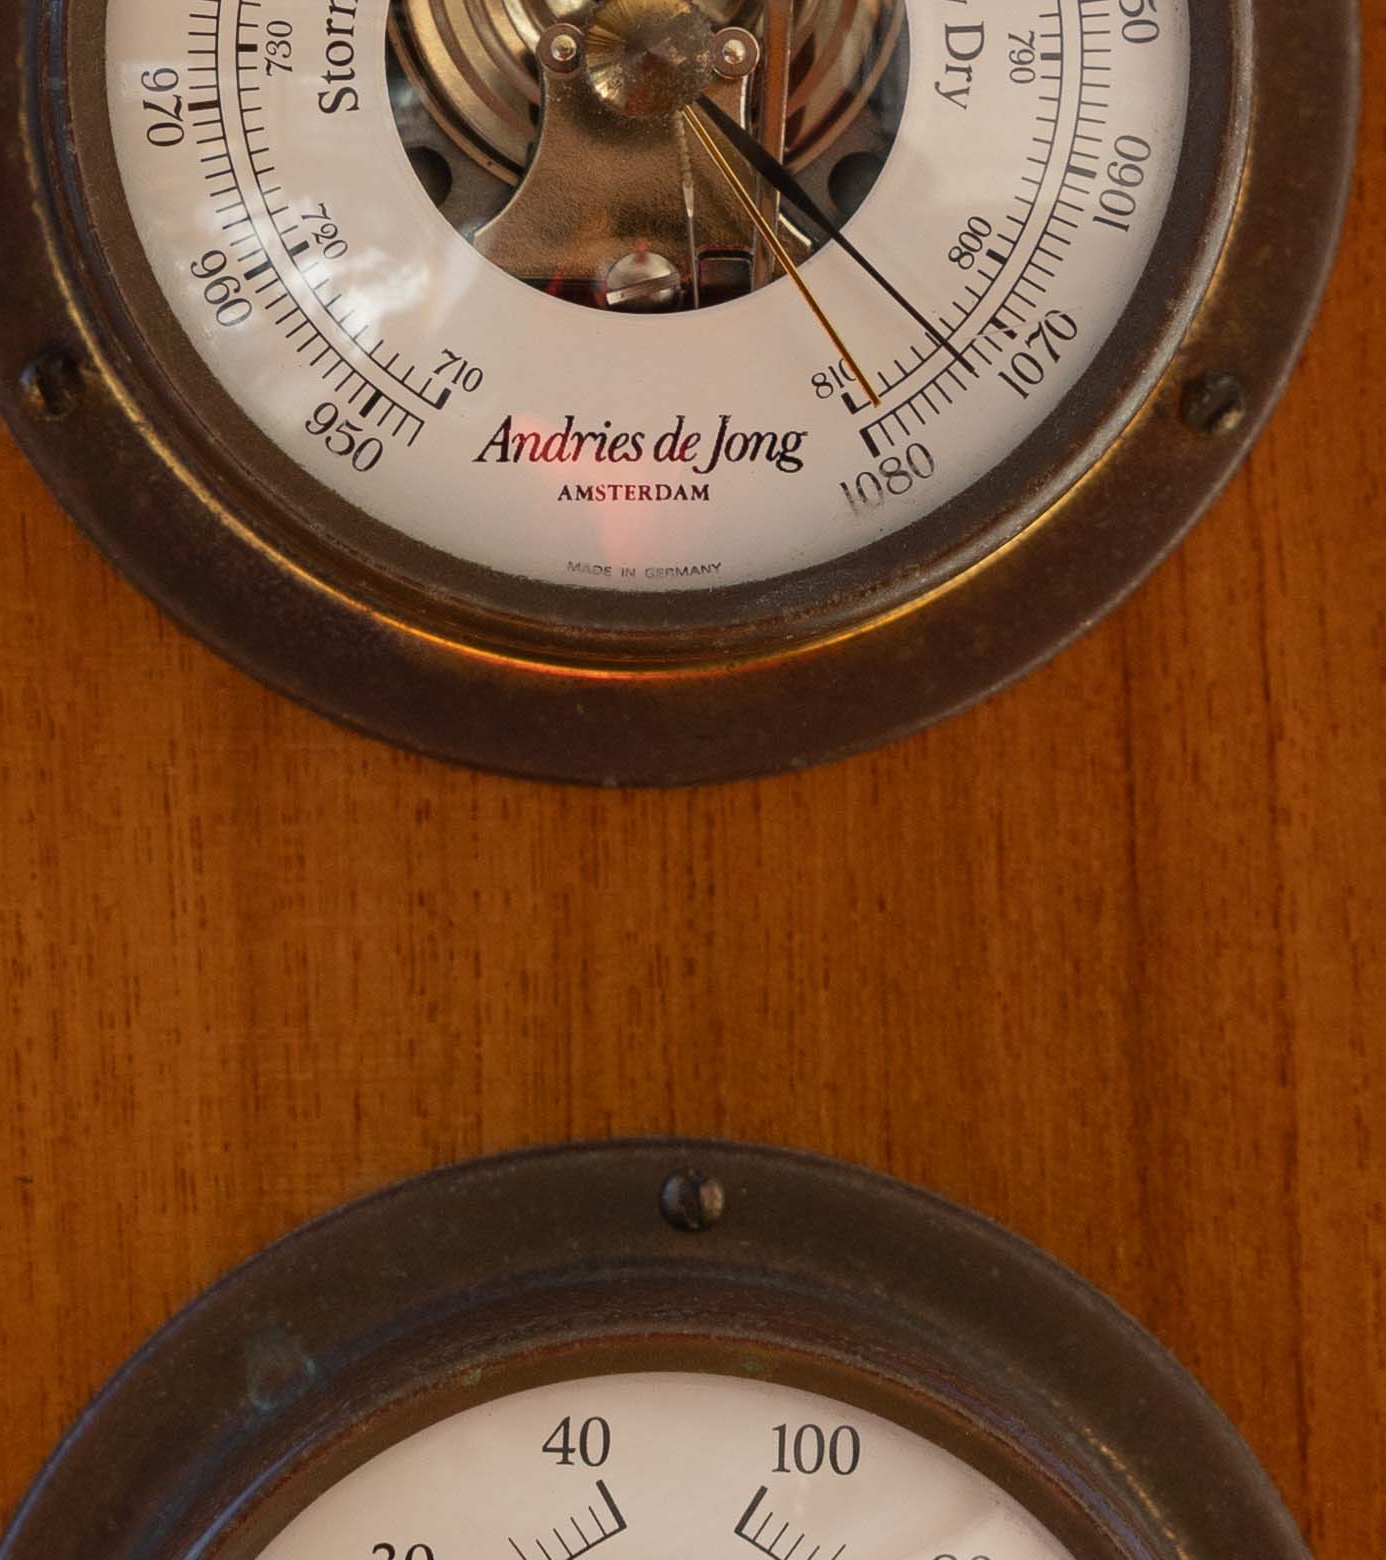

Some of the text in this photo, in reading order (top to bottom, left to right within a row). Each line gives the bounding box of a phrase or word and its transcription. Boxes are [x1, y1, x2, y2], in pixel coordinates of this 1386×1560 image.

[265, 20, 294, 77] 730
[935, 21, 987, 111] Dry
[1007, 29, 1036, 85] 790
[140, 62, 182, 147] 970
[1091, 134, 1152, 235] 1060
[297, 203, 349, 261] 720
[947, 214, 994, 267] 800
[189, 248, 254, 331] 960
[433, 348, 484, 393] 710
[997, 309, 1080, 403] 1070
[304, 403, 384, 473] 950
[472, 414, 808, 474] Andries de Jong
[557, 483, 710, 502] AMSTERDAM
[839, 443, 935, 516] 1080
[567, 561, 722, 578] MADE IN GERMANY
[541, 1416, 610, 1468] 40
[770, 1425, 861, 1475] 100
